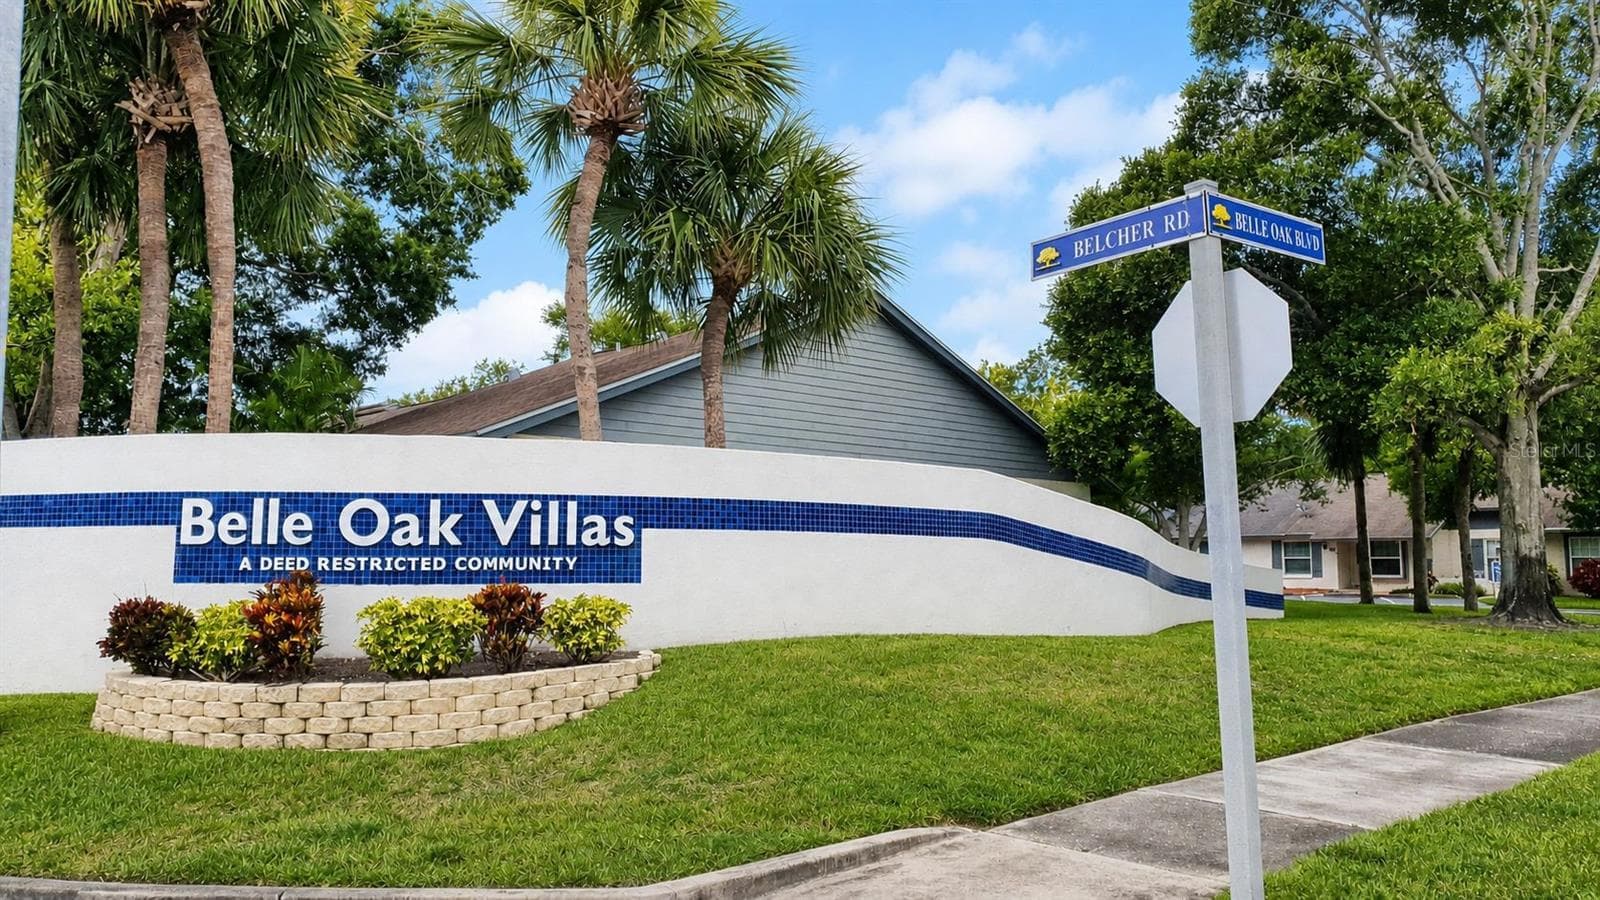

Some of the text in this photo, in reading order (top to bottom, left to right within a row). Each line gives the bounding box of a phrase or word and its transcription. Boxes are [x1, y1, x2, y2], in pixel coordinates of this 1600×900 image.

[1073, 209, 1190, 259] BELCHER RD
[1235, 212, 1320, 251] BELLE OAK BLVD
[180, 498, 635, 547] Belle Oak Villas
[238, 556, 577, 572] A DEED RESTRICTED COMMUNITY
